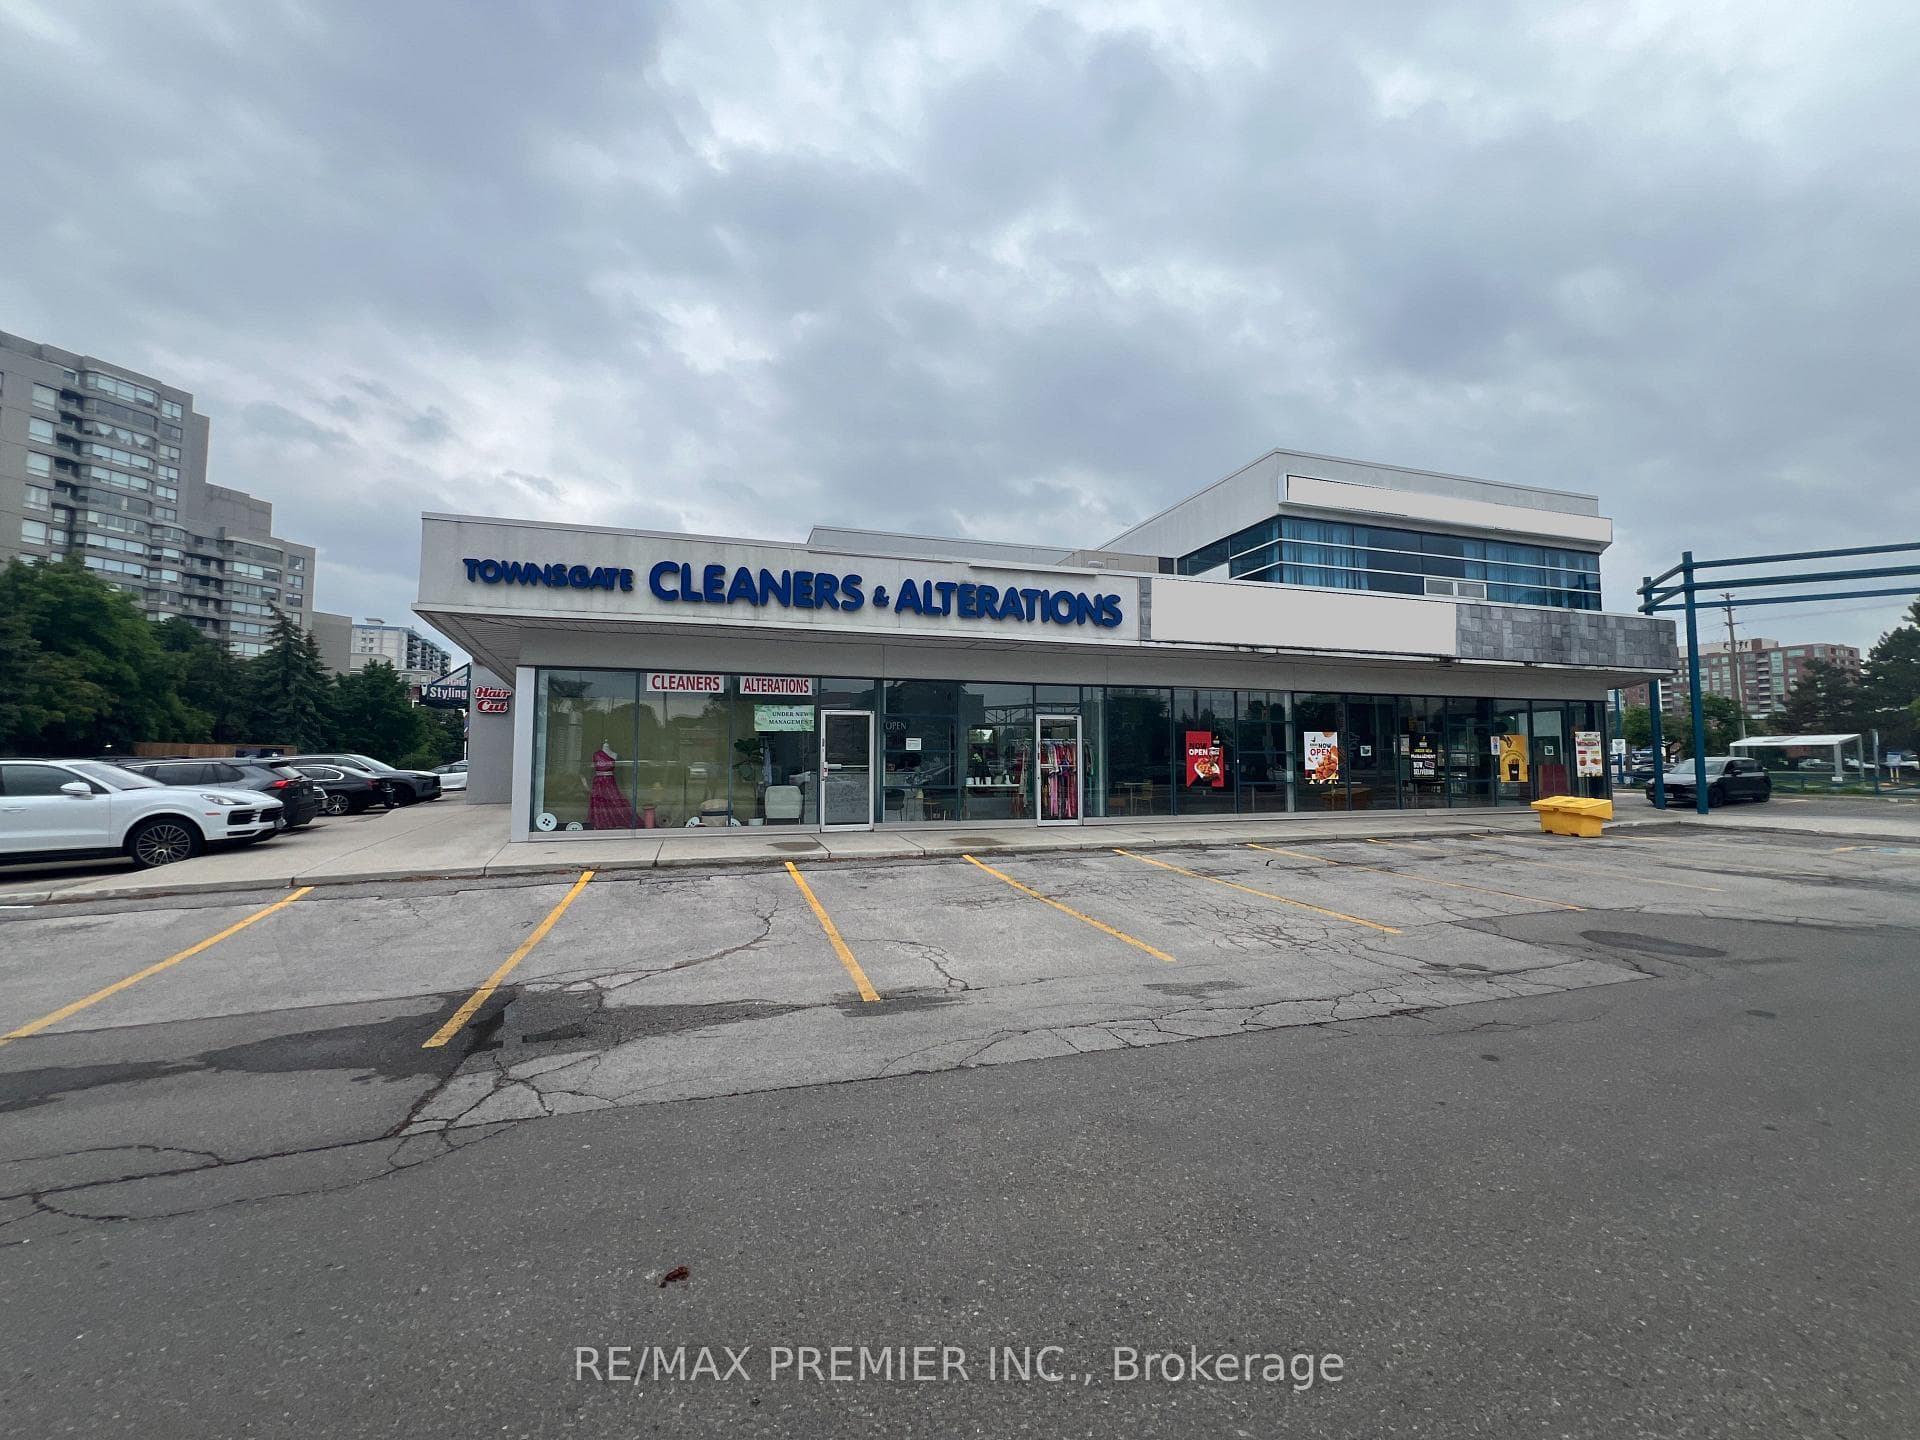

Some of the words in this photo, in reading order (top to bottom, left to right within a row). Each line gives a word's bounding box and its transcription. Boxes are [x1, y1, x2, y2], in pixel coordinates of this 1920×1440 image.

[463, 558, 633, 592] TOWNSGATE
[649, 561, 865, 612] CLEANERS
[873, 585, 890, 607] &
[894, 578, 1123, 628] ALTERATIONS
[651, 674, 720, 691] CLEANERS
[743, 677, 809, 694] ALTERATIONS
[429, 687, 468, 700] Styling
[474, 686, 511, 699] Hair
[477, 700, 508, 712] Cut
[885, 721, 907, 730] OPEN
[1188, 748, 1209, 756] OPEN
[1310, 748, 1331, 756] OPEN
